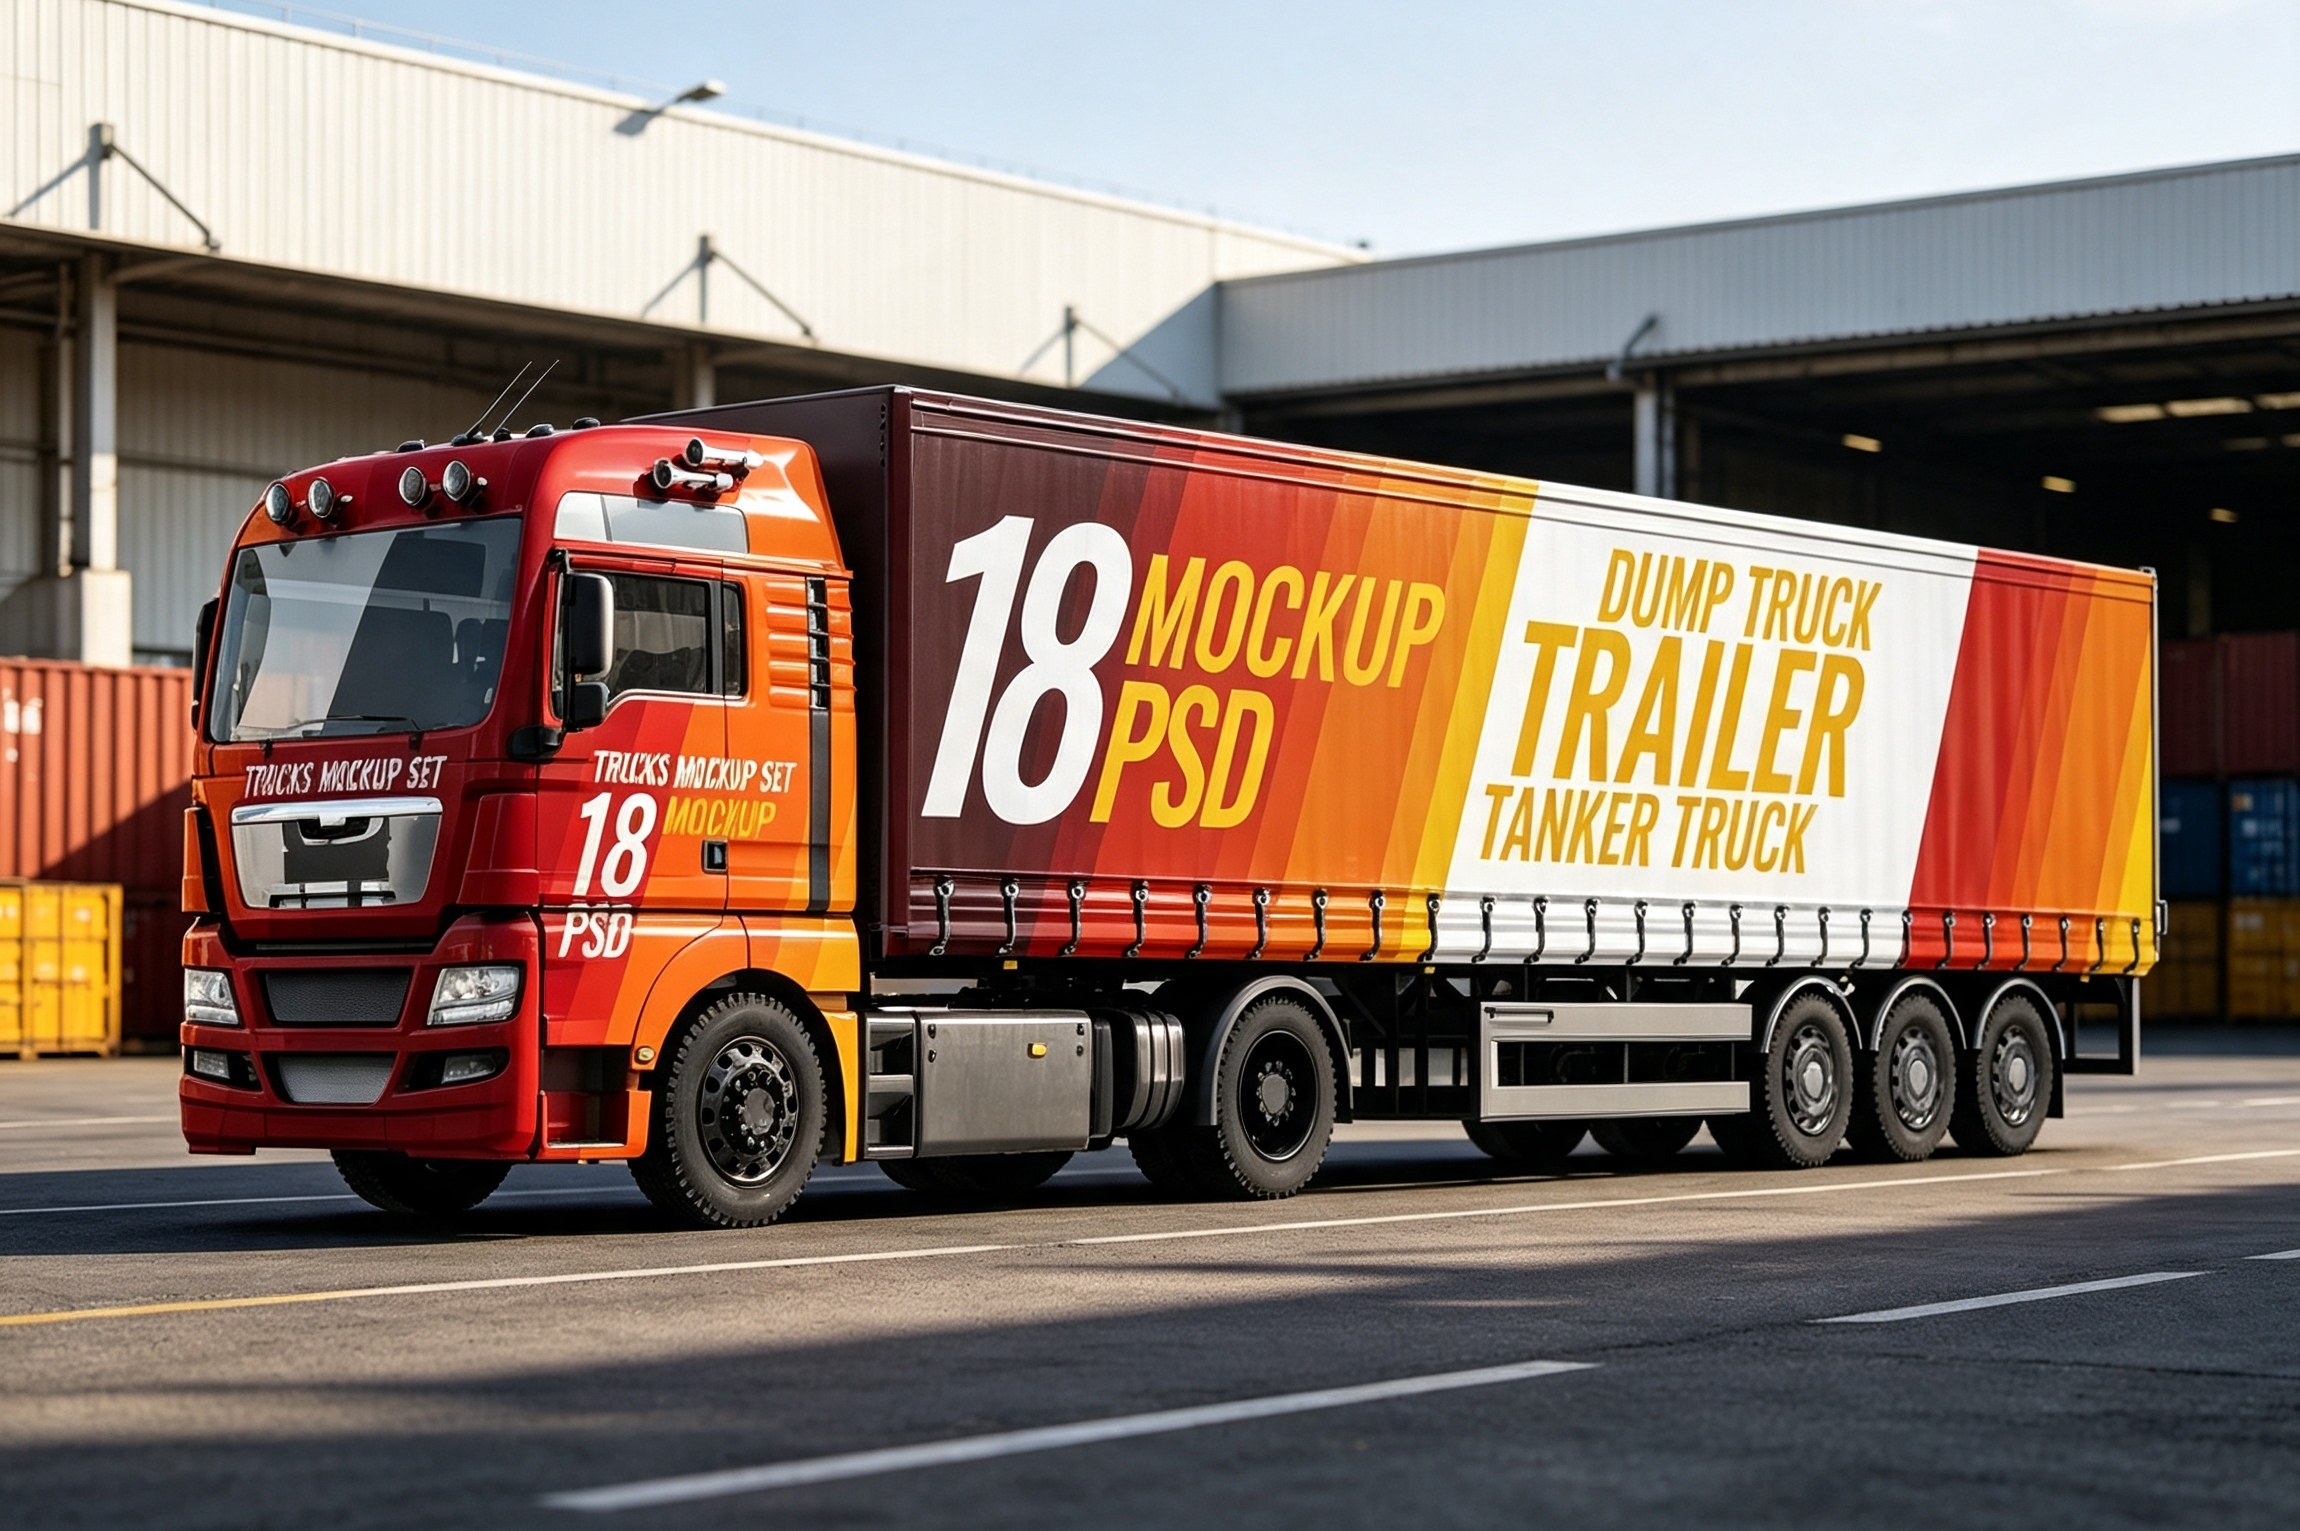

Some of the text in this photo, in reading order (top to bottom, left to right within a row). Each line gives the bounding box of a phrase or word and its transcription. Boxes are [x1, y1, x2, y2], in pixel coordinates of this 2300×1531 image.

[1125, 553, 1446, 688] MOCKUP
[1597, 548, 1882, 651] DUMP TRUCK
[921, 515, 1132, 825] 18
[1510, 620, 1865, 798] TRAILER
[317, 757, 403, 793] MOCKUP
[406, 755, 448, 789] SET
[673, 755, 758, 791] MOCKUP
[759, 760, 797, 793] SET
[1089, 680, 1275, 828] PSD
[572, 792, 658, 898] 18
[662, 795, 777, 838] MOCKUP
[1479, 783, 1819, 874] TANKER TRUCK
[558, 903, 633, 958] PSD
